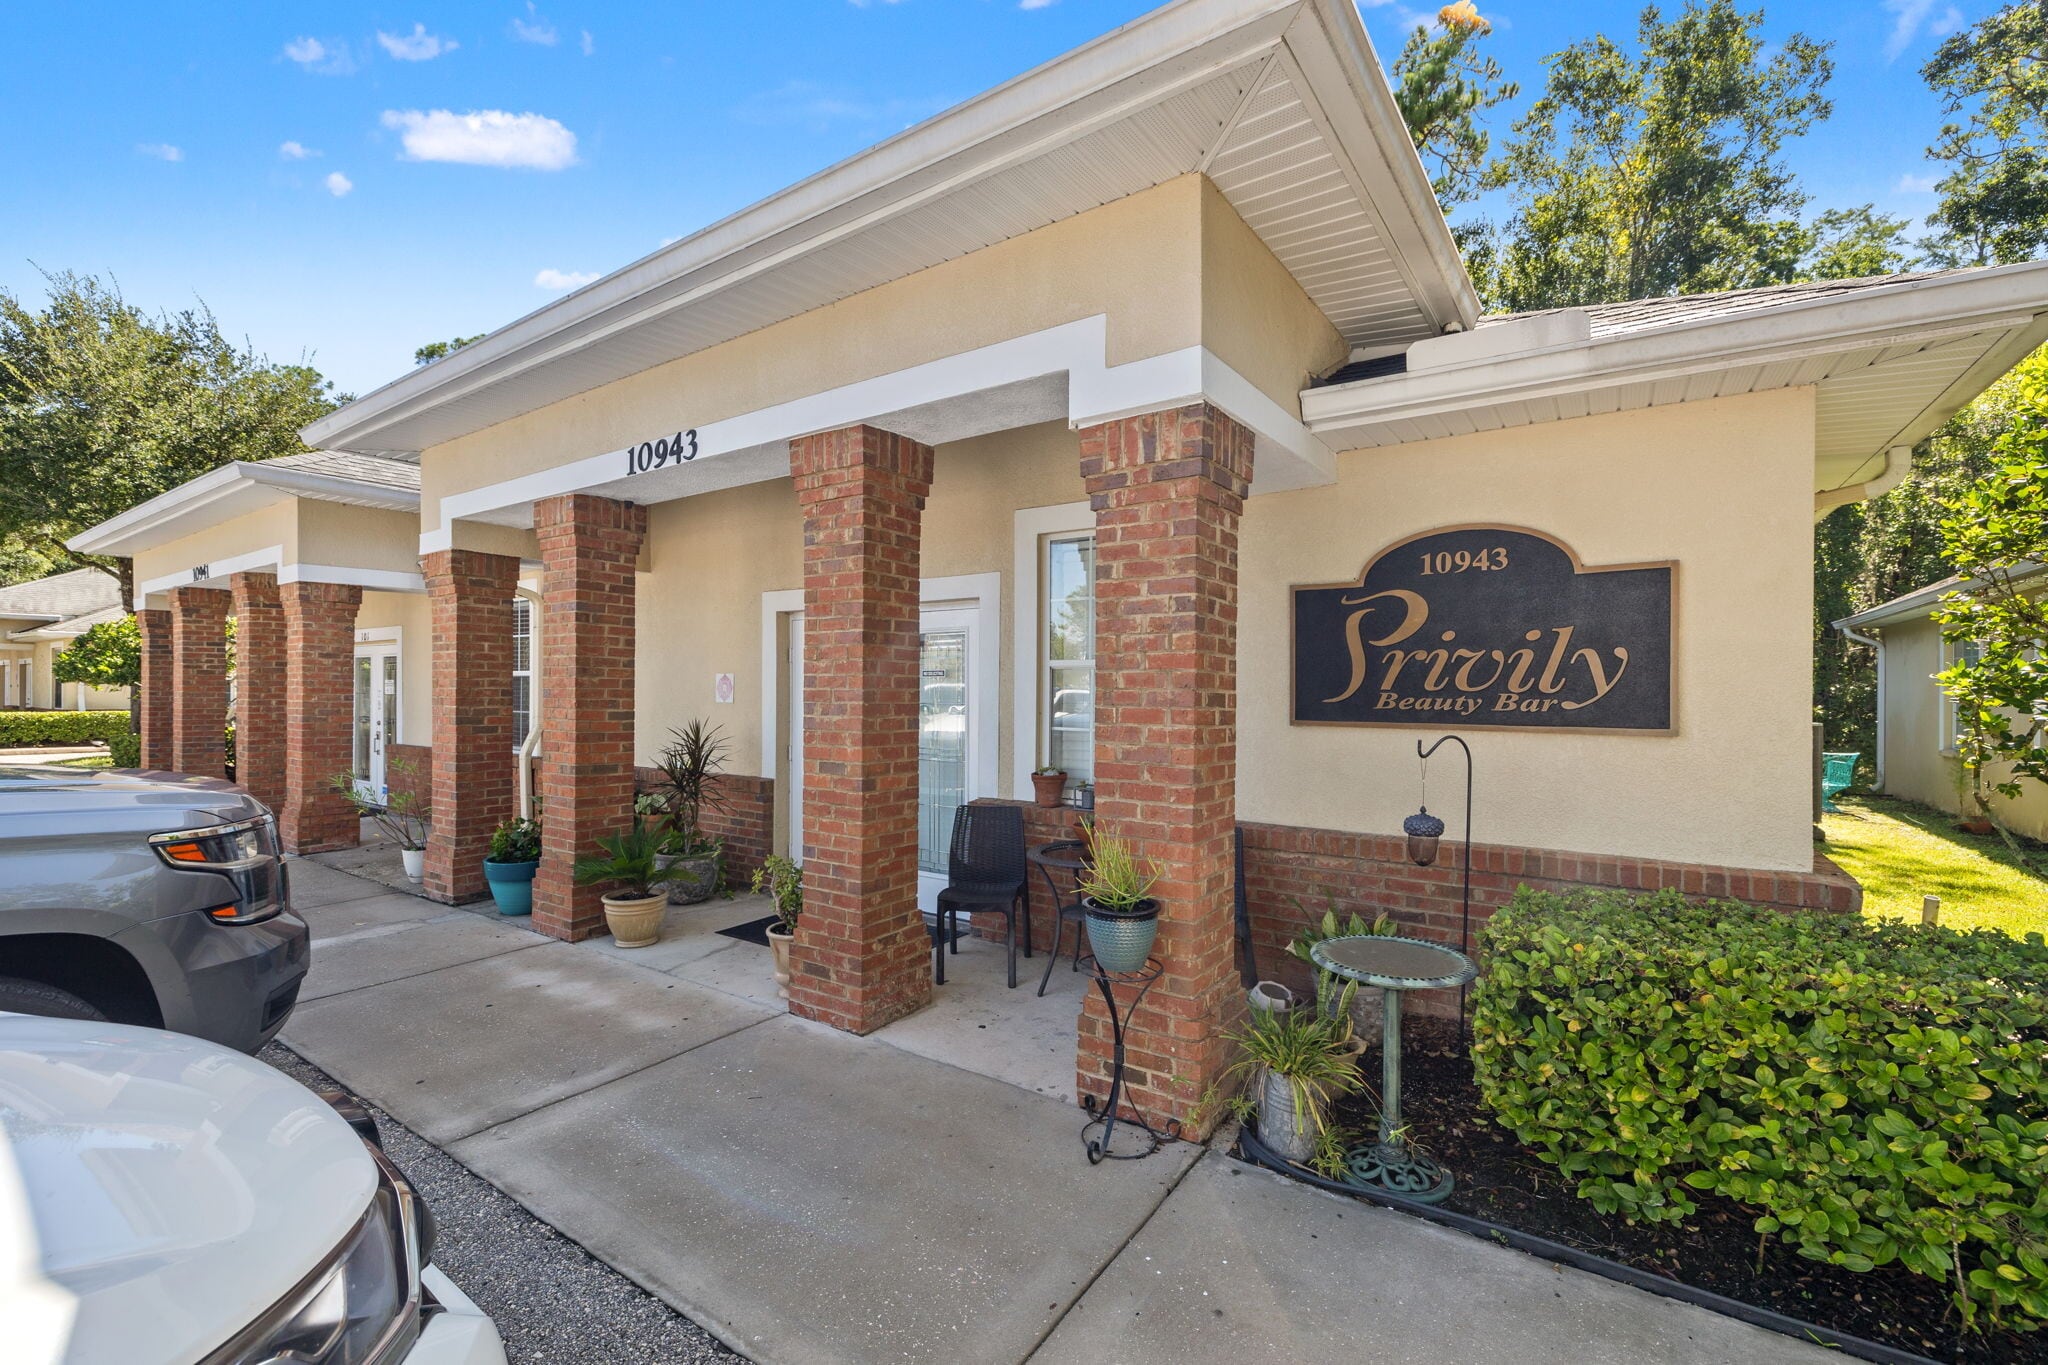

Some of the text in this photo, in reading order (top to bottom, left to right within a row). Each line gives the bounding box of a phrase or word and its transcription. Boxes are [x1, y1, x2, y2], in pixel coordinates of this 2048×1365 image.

[627, 429, 698, 476] 10943
[1420, 547, 1508, 576] 10943
[1322, 589, 1628, 710] Privily
[1373, 692, 1558, 716] Beauty Bar
